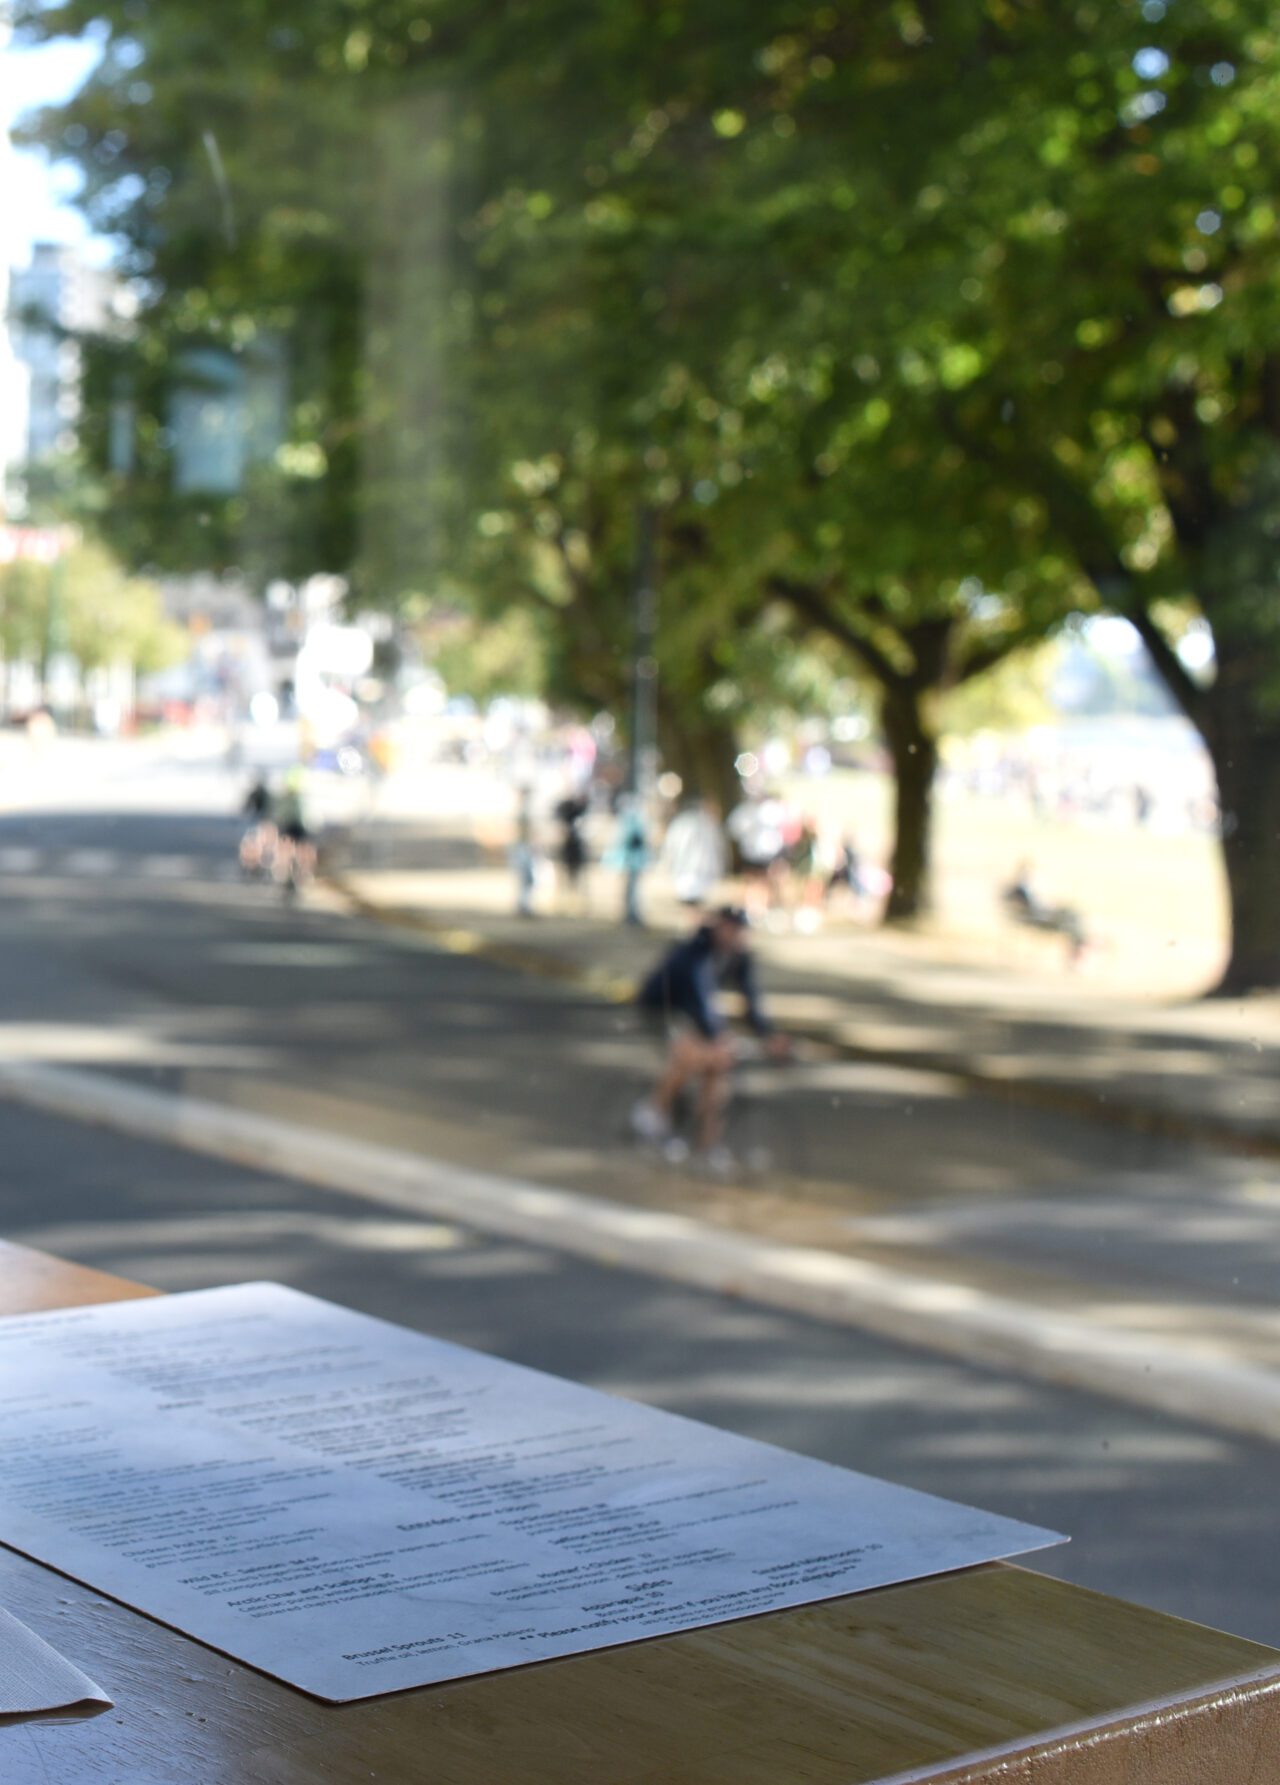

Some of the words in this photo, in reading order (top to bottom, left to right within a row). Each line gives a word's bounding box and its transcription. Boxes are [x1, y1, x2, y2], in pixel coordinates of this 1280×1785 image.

[340, 1645, 390, 1661] Brussel
[390, 1635, 445, 1652] Sprouts
[355, 1655, 398, 1668] Truffle
